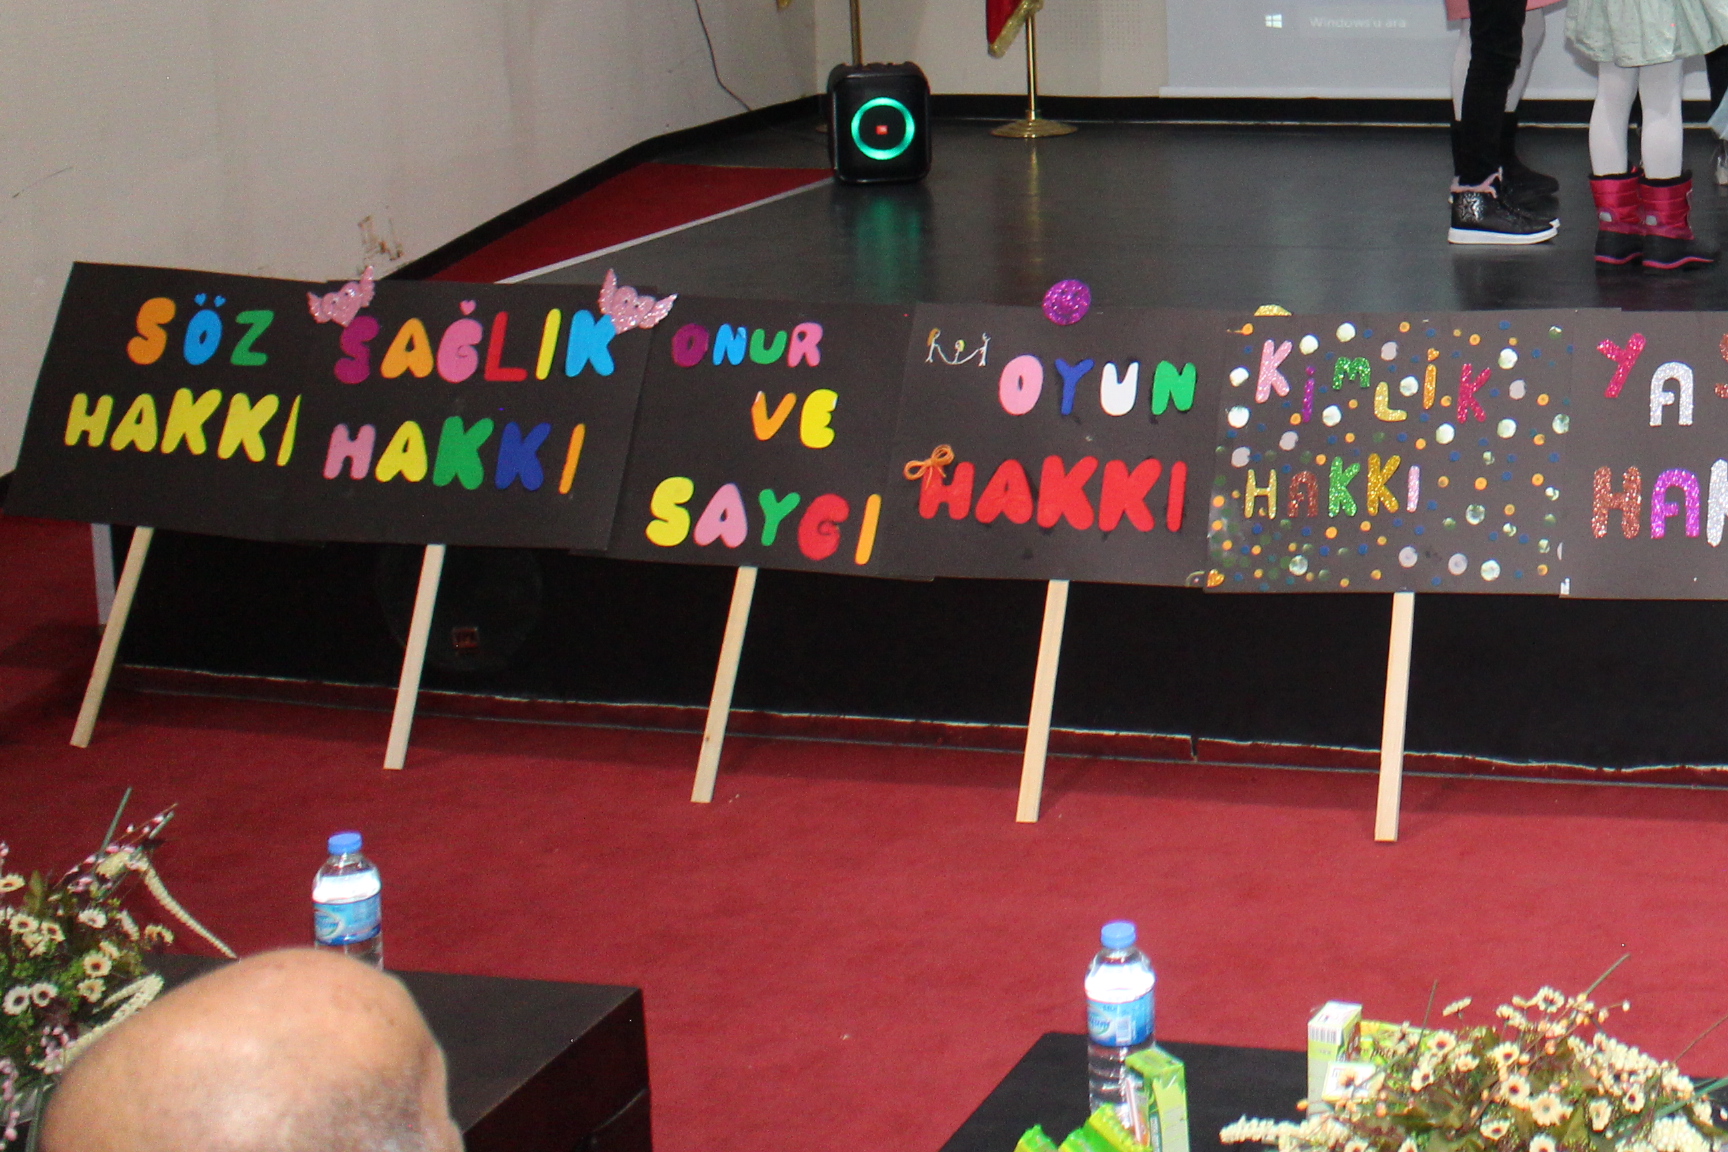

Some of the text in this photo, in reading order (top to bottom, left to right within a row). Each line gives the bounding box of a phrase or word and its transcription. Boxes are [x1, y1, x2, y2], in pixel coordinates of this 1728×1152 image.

[126, 293, 275, 366] SÖZ
[671, 321, 823, 368] ONUR
[750, 388, 839, 449] VE
[999, 354, 1197, 416] OYUN
[64, 387, 301, 466] HAKKI
[322, 415, 586, 495] HAKKI
[645, 477, 882, 566] SAYGI
[918, 455, 1188, 532] HAKKI
[1244, 453, 1421, 520] HAKKI
